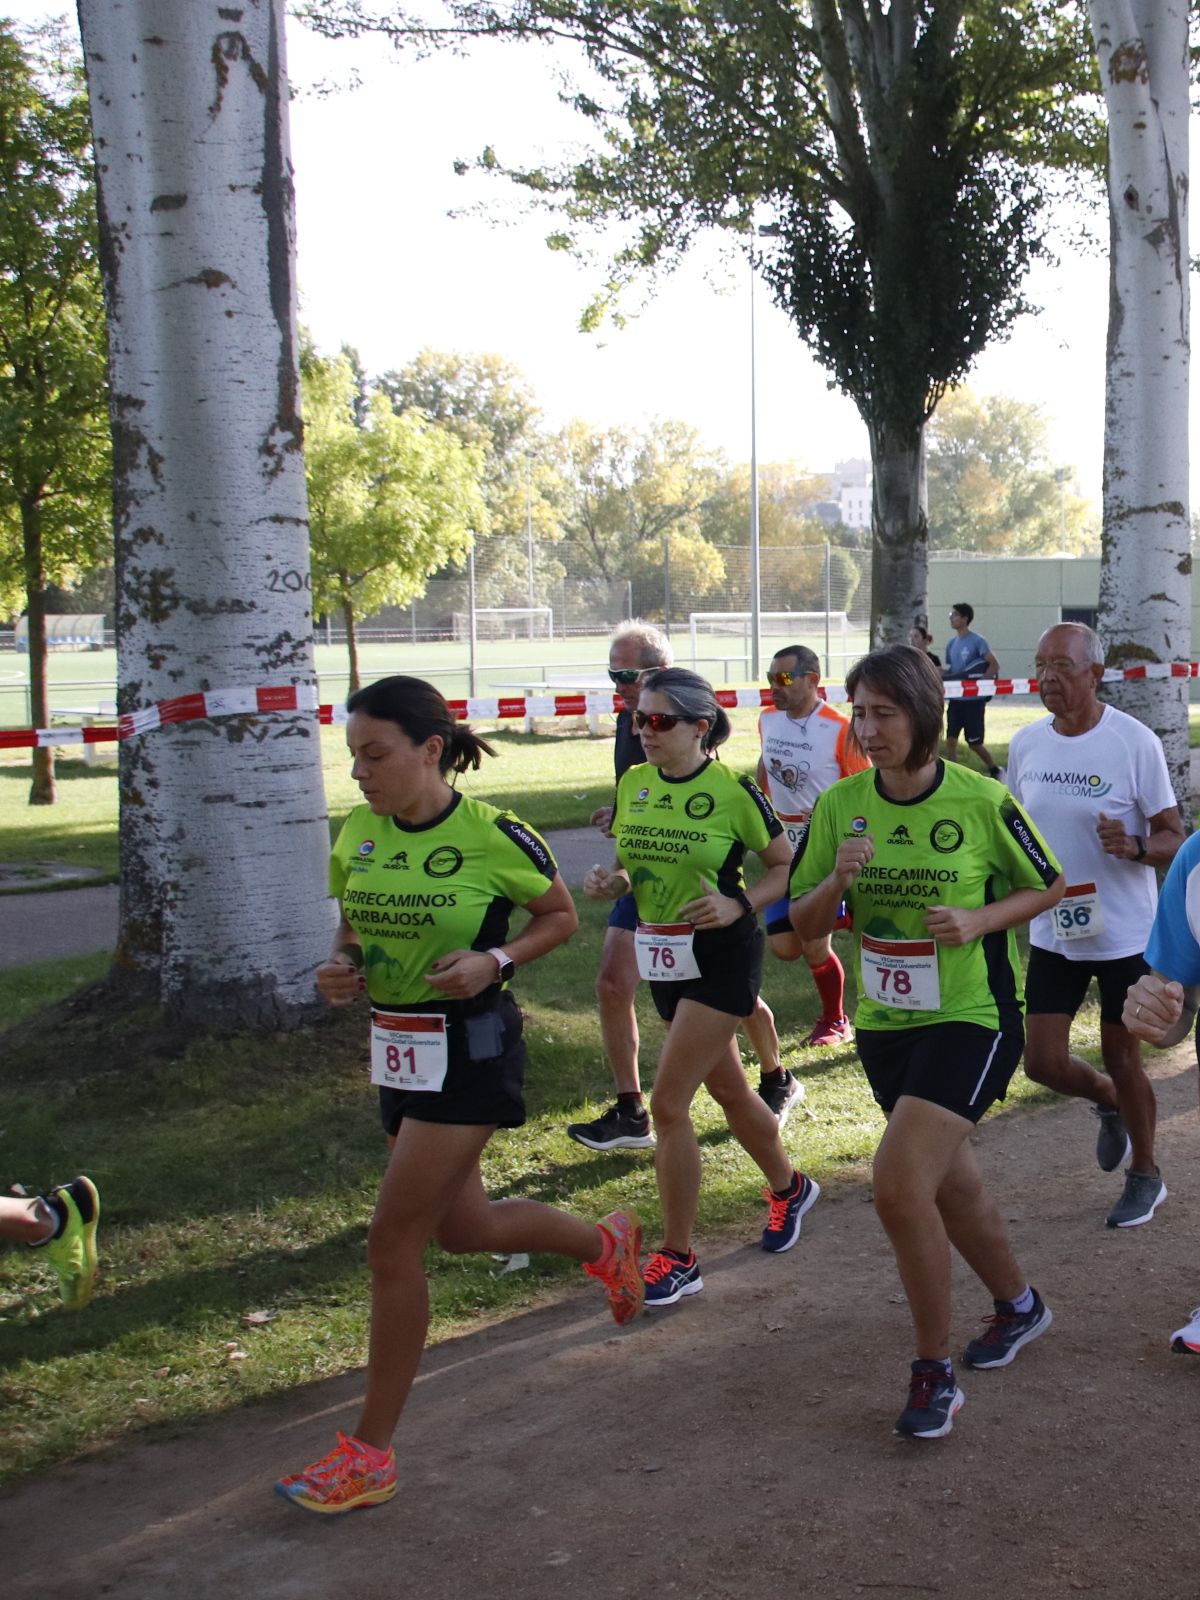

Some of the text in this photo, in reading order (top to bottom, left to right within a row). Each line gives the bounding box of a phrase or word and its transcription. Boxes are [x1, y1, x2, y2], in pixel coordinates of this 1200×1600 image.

[510, 824, 548, 865] CARBAJOSA
[619, 837, 690, 855] CARBAJOSA
[1013, 819, 1048, 870] CARBAJOSA
[628, 852, 678, 865] SALAMANCA
[861, 866, 959, 882] RRECAMINOS
[344, 889, 457, 907] ORRECAMINOS
[857, 882, 940, 898] CARBAJOSA
[871, 899, 927, 911] ALAMANCA
[345, 907, 436, 927] CARBAJOSA
[358, 926, 420, 941] SALAMANCA
[648, 947, 675, 969] 76
[876, 967, 912, 995] 78
[386, 1045, 416, 1074] 81
